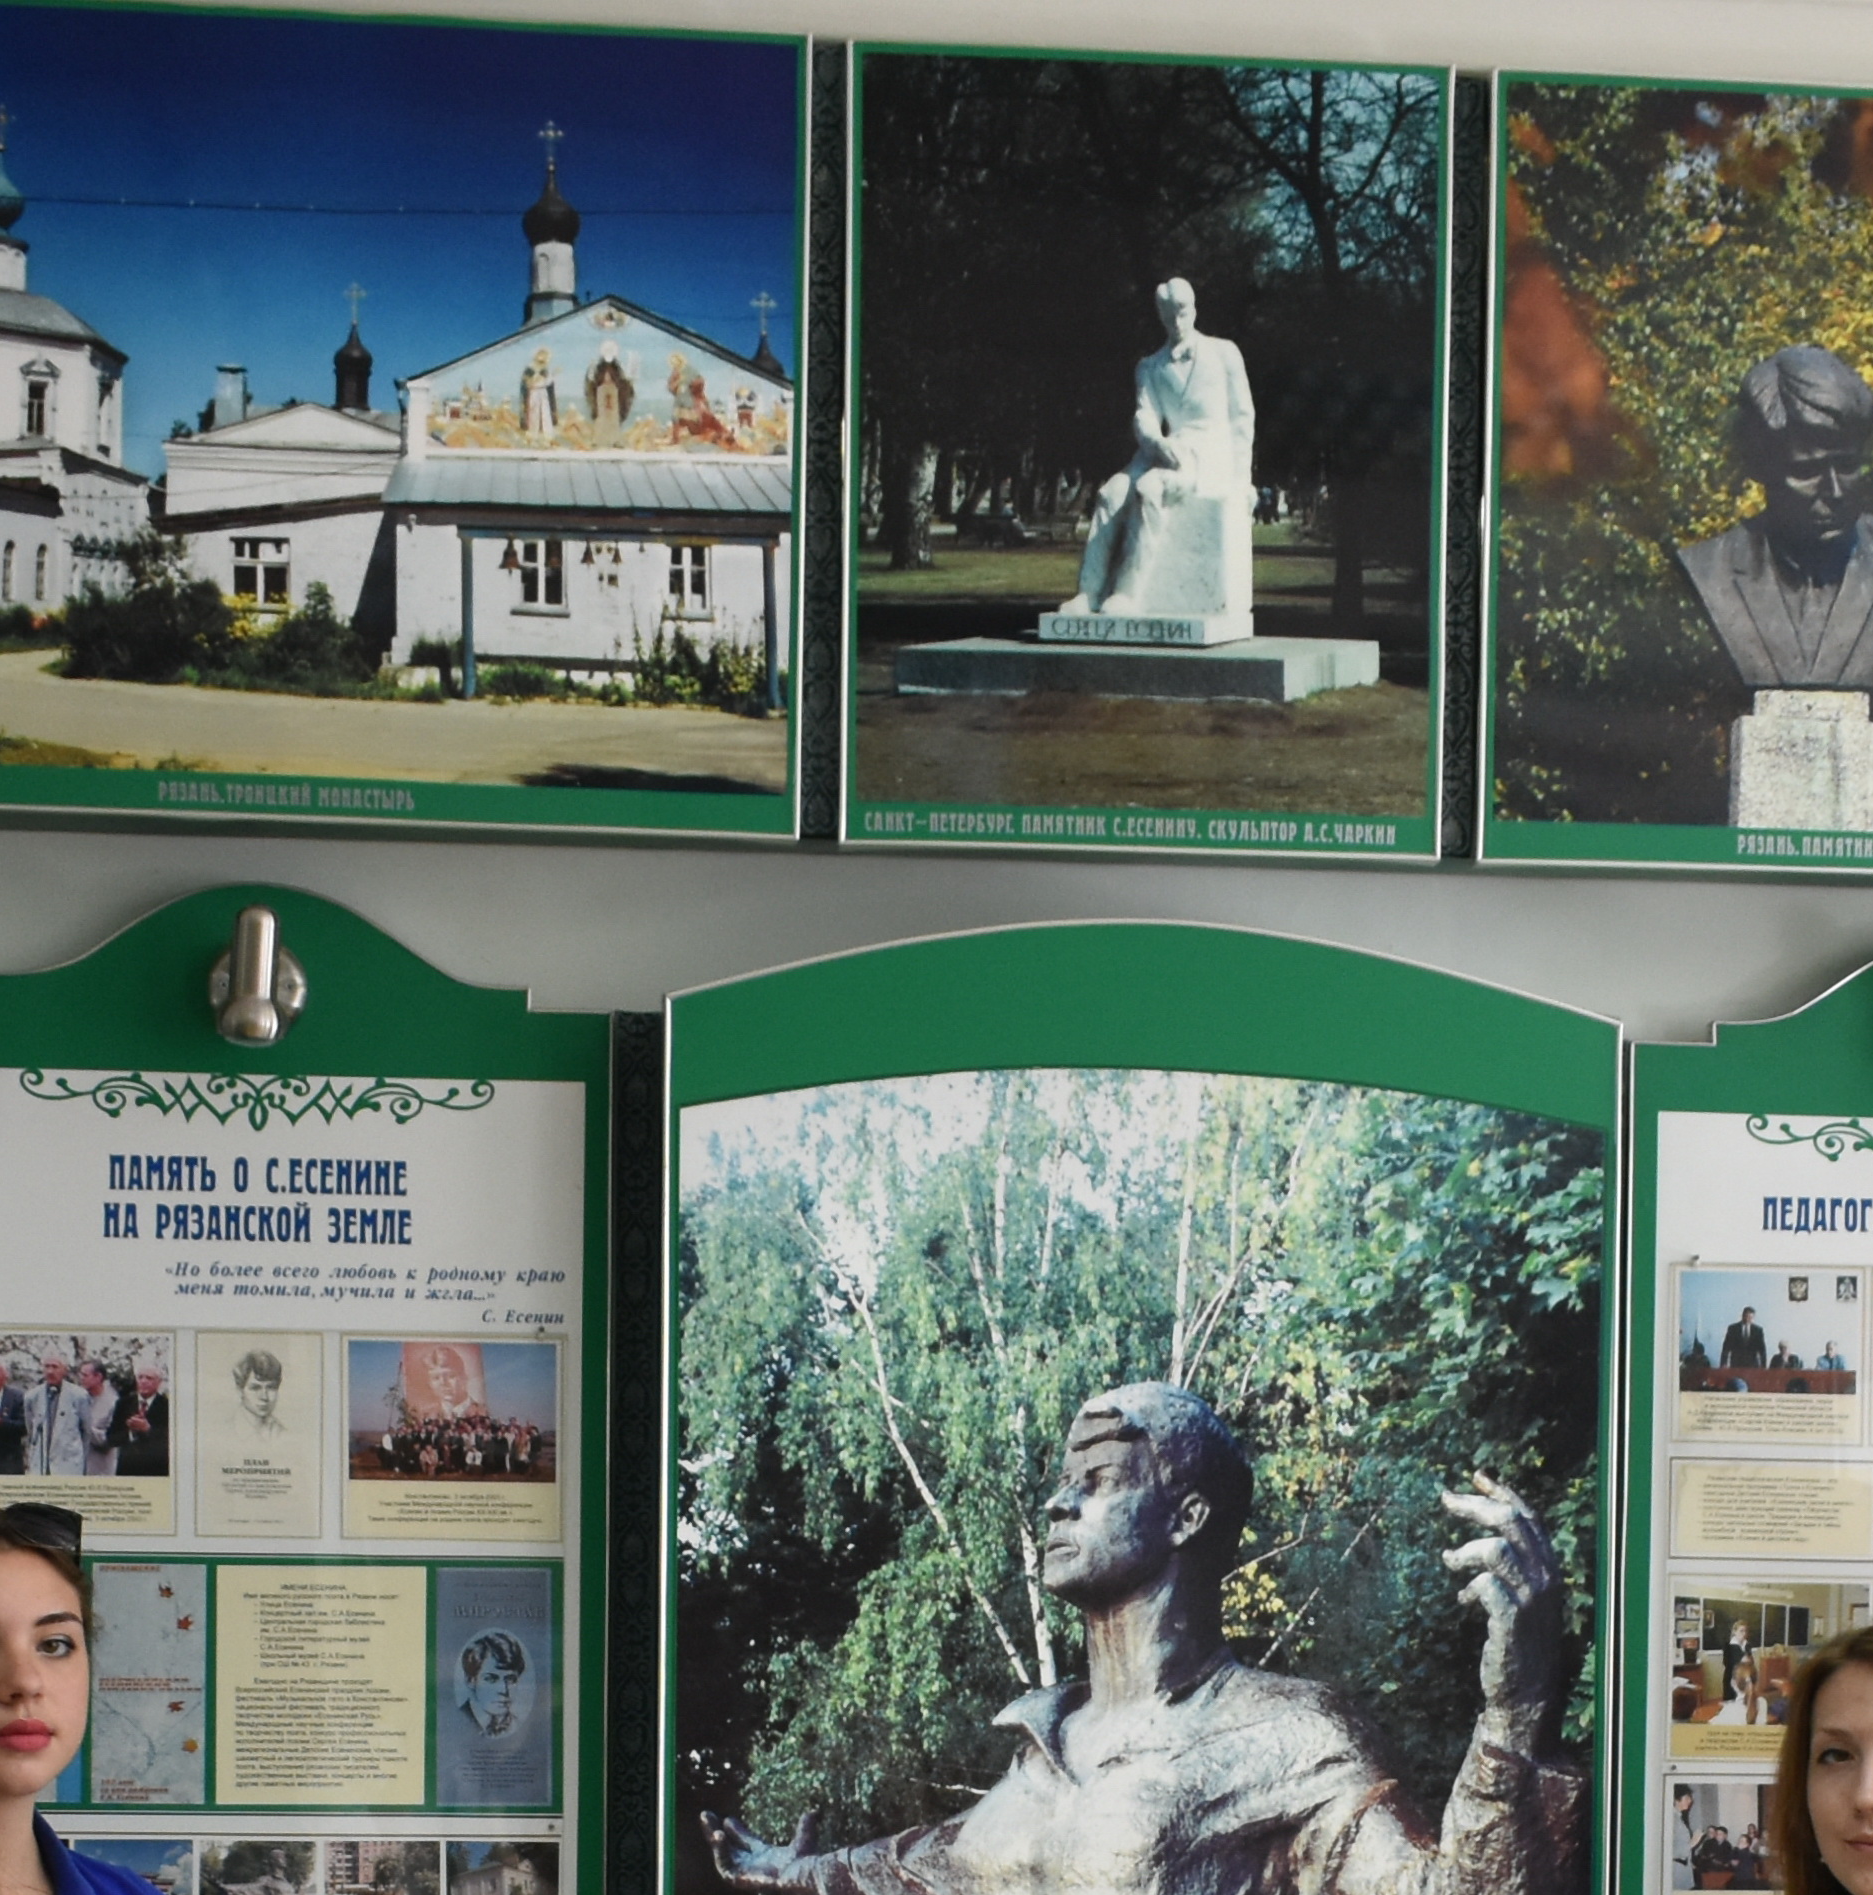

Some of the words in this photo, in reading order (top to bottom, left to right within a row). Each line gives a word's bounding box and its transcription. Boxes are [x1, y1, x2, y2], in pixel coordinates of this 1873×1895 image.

[317, 786, 416, 811] МОНАСТЫРЬ
[1022, 813, 1107, 837] ПАМЯТНИК
[1114, 816, 1202, 840] С.ЕСЕНИНУ.
[1208, 819, 1298, 842] СКУЛЬПТОР
[1304, 821, 1397, 846] А.С.ЧАРКИН
[108, 1154, 217, 1192] ПАМЯТЬ
[234, 1158, 249, 1192] О
[266, 1158, 408, 1197] С.ЕСЕНИНЕ
[102, 1202, 139, 1240] НА
[155, 1197, 312, 1244] РЯЗАНСКОЙ
[327, 1206, 412, 1245] ЗЕМЛЕ
[164, 1262, 200, 1280] «Но
[209, 1262, 263, 1280] более
[272, 1267, 321, 1283] всего
[329, 1263, 396, 1282] любовь
[405, 1269, 418, 1282] к
[427, 1264, 507, 1288] родному
[516, 1269, 566, 1287] краю
[174, 1284, 224, 1297] меня
[320, 1284, 395, 1303] мучила
[405, 1286, 418, 1299] и
[481, 1307, 497, 1325] С.
[504, 1309, 565, 1326] Есенин
